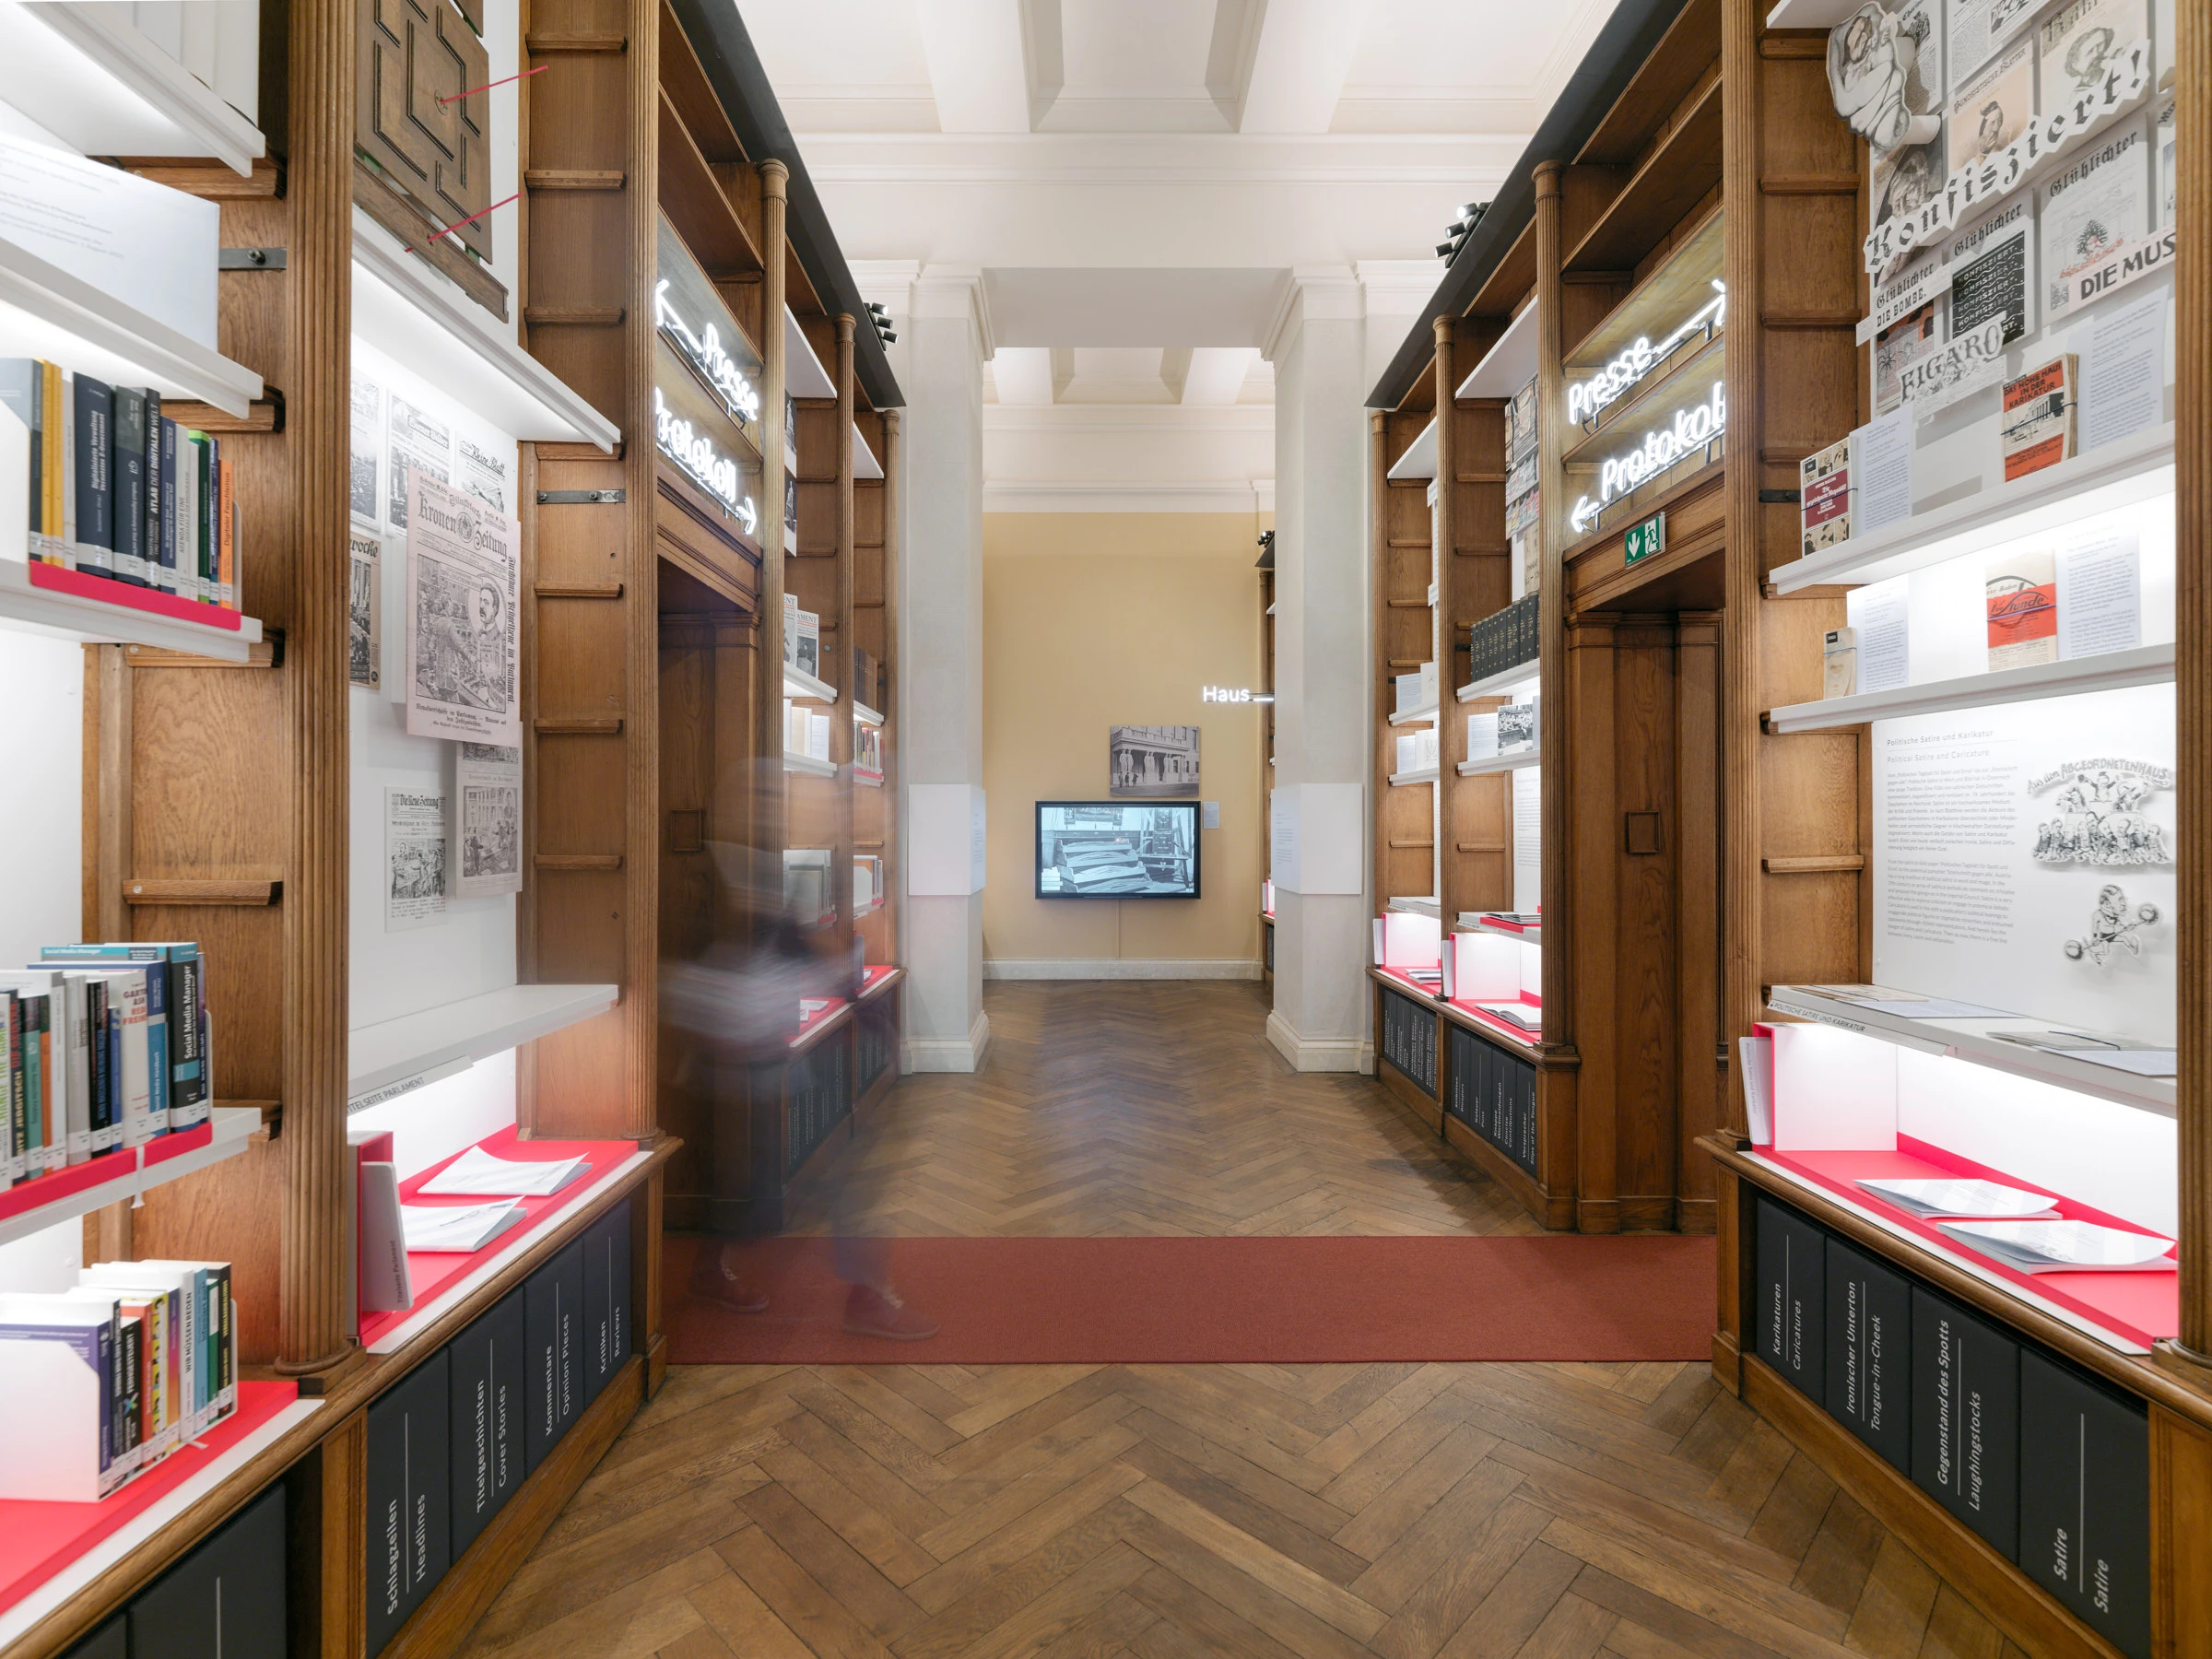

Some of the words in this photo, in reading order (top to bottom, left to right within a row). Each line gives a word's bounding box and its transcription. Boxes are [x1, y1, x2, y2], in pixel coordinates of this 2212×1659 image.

[2050, 132, 2137, 197] Glühlichter
[1954, 201, 2023, 256] Glühlichter
[1877, 263, 1934, 308] Glühlichter
[2081, 264, 2118, 300] DIE
[1877, 309, 1890, 327] DIE
[1894, 288, 1926, 316] BOMBE.
[705, 323, 759, 420] Presse
[1569, 336, 1653, 425] Presse
[1900, 324, 2006, 402] FIGARO
[2005, 385, 2017, 396] DAS
[2018, 374, 2040, 389] HOHE
[2009, 382, 2054, 408] KARIKATUR
[2020, 387, 2030, 395] IN
[2031, 379, 2045, 392] DER
[90, 410, 99, 447] Verwaltung
[150, 403, 159, 426] WELT
[150, 427, 159, 468] DIGITALEN
[471, 444, 488, 464] Kleine
[490, 457, 506, 475] Blatt
[90, 448, 99, 489] Digitalisierte
[99, 457, 107, 491] Vernetztes
[150, 469, 159, 487] DER
[150, 487, 159, 513] ATLAS
[418, 490, 457, 535] Kronen
[474, 520, 508, 563] Zeitung
[1203, 686, 1250, 703] Haus
[1888, 736, 1918, 747] Politische
[1959, 730, 1994, 739] Karikatur
[1888, 754, 1913, 763] Political
[1914, 753, 1935, 761] Satire
[1951, 749, 1990, 759] Caricature
[2061, 758, 2169, 780] ABGEORDNETENHAUS
[419, 795, 438, 809] Zeitung
[183, 965, 194, 1005] Manager
[183, 1006, 193, 1033] Media
[1774, 1002, 1802, 1015] POLITISCHE
[1801, 1009, 1818, 1019] SATIRE
[1819, 1015, 1831, 1023] UND
[1832, 1018, 1865, 1031] KARIKATUR
[183, 1034, 193, 1059] Social
[383, 1077, 424, 1099] PARLAMENT
[391, 1241, 399, 1273] Parlament
[394, 1275, 403, 1303] Titelseite
[1772, 1283, 1782, 1356] Karikaturen
[1848, 1281, 1856, 1342] Unterton
[1793, 1300, 1801, 1371] Caricatures
[1940, 1320, 1949, 1365] Spotts
[1846, 1346, 1856, 1415] Ironischer
[1871, 1314, 1881, 1431] Tongue-in-Cheek
[1940, 1367, 1948, 1392] des
[477, 1380, 485, 1513] Titelgeschichten
[1937, 1394, 1948, 1485] Gegenstand
[1968, 1390, 1982, 1512] Laughingstocks
[499, 1444, 507, 1488] Cover
[387, 1499, 398, 1615] Schlagzeilen
[416, 1493, 426, 1583] Headlines
[2053, 1527, 2068, 1582] Satire
[2093, 1559, 2110, 1614] Satire
